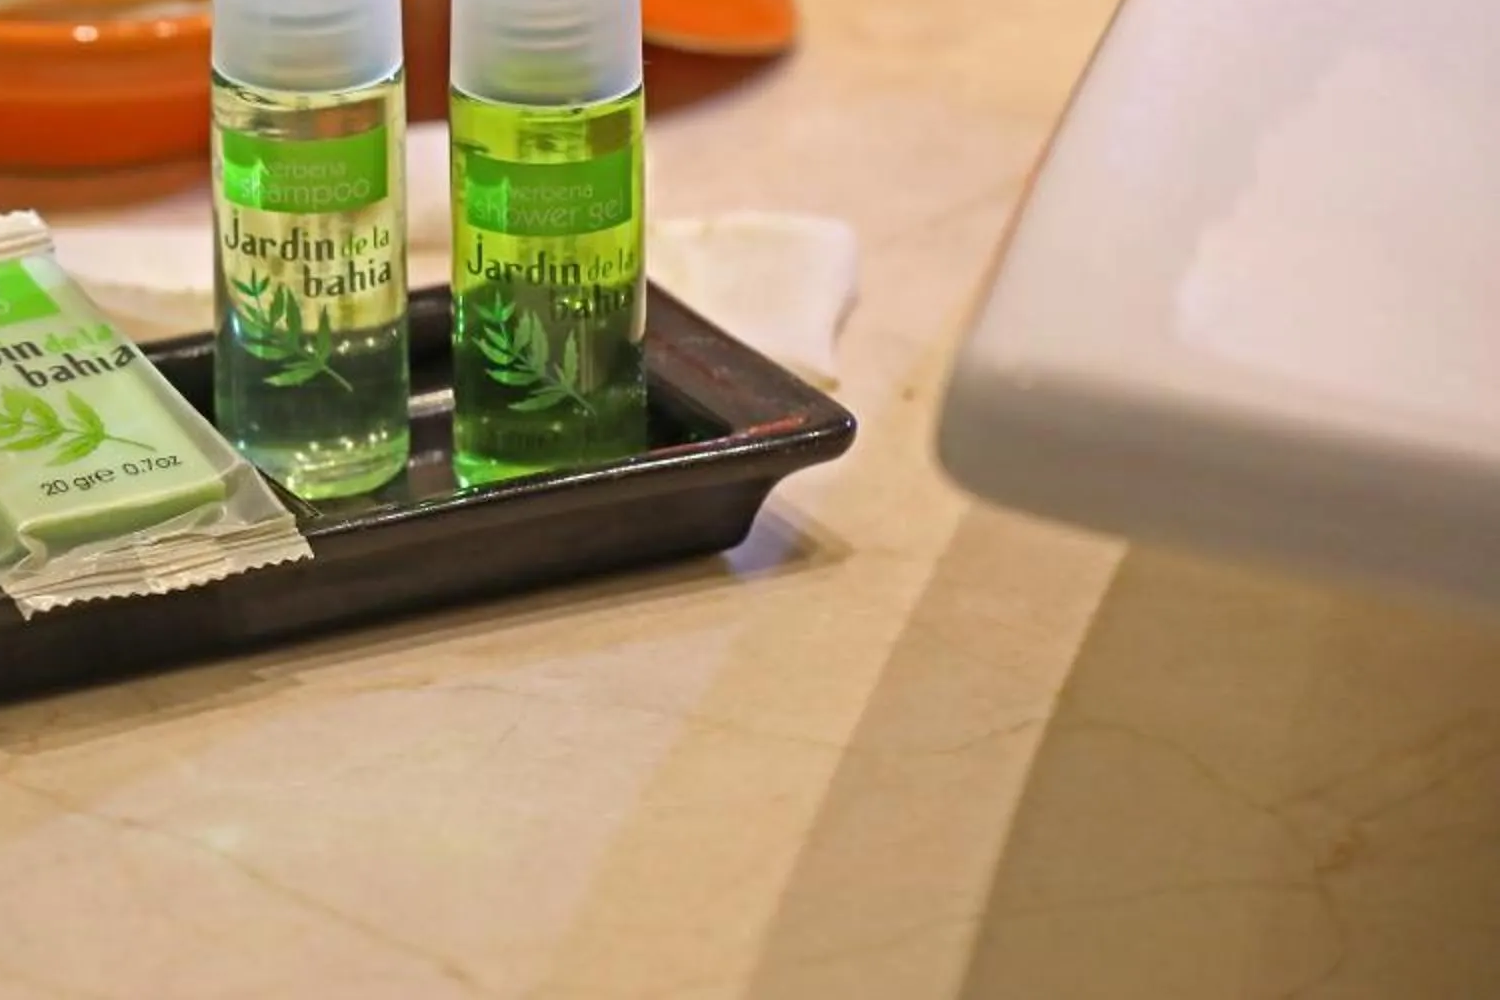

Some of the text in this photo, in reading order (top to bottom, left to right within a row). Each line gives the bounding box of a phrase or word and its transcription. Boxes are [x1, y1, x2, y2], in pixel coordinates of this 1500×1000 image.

[340, 233, 368, 258] de
[372, 225, 390, 247] la
[303, 259, 392, 298] bahia
[588, 254, 613, 282] de
[14, 343, 137, 389] bahia
[40, 479, 69, 496] 20
